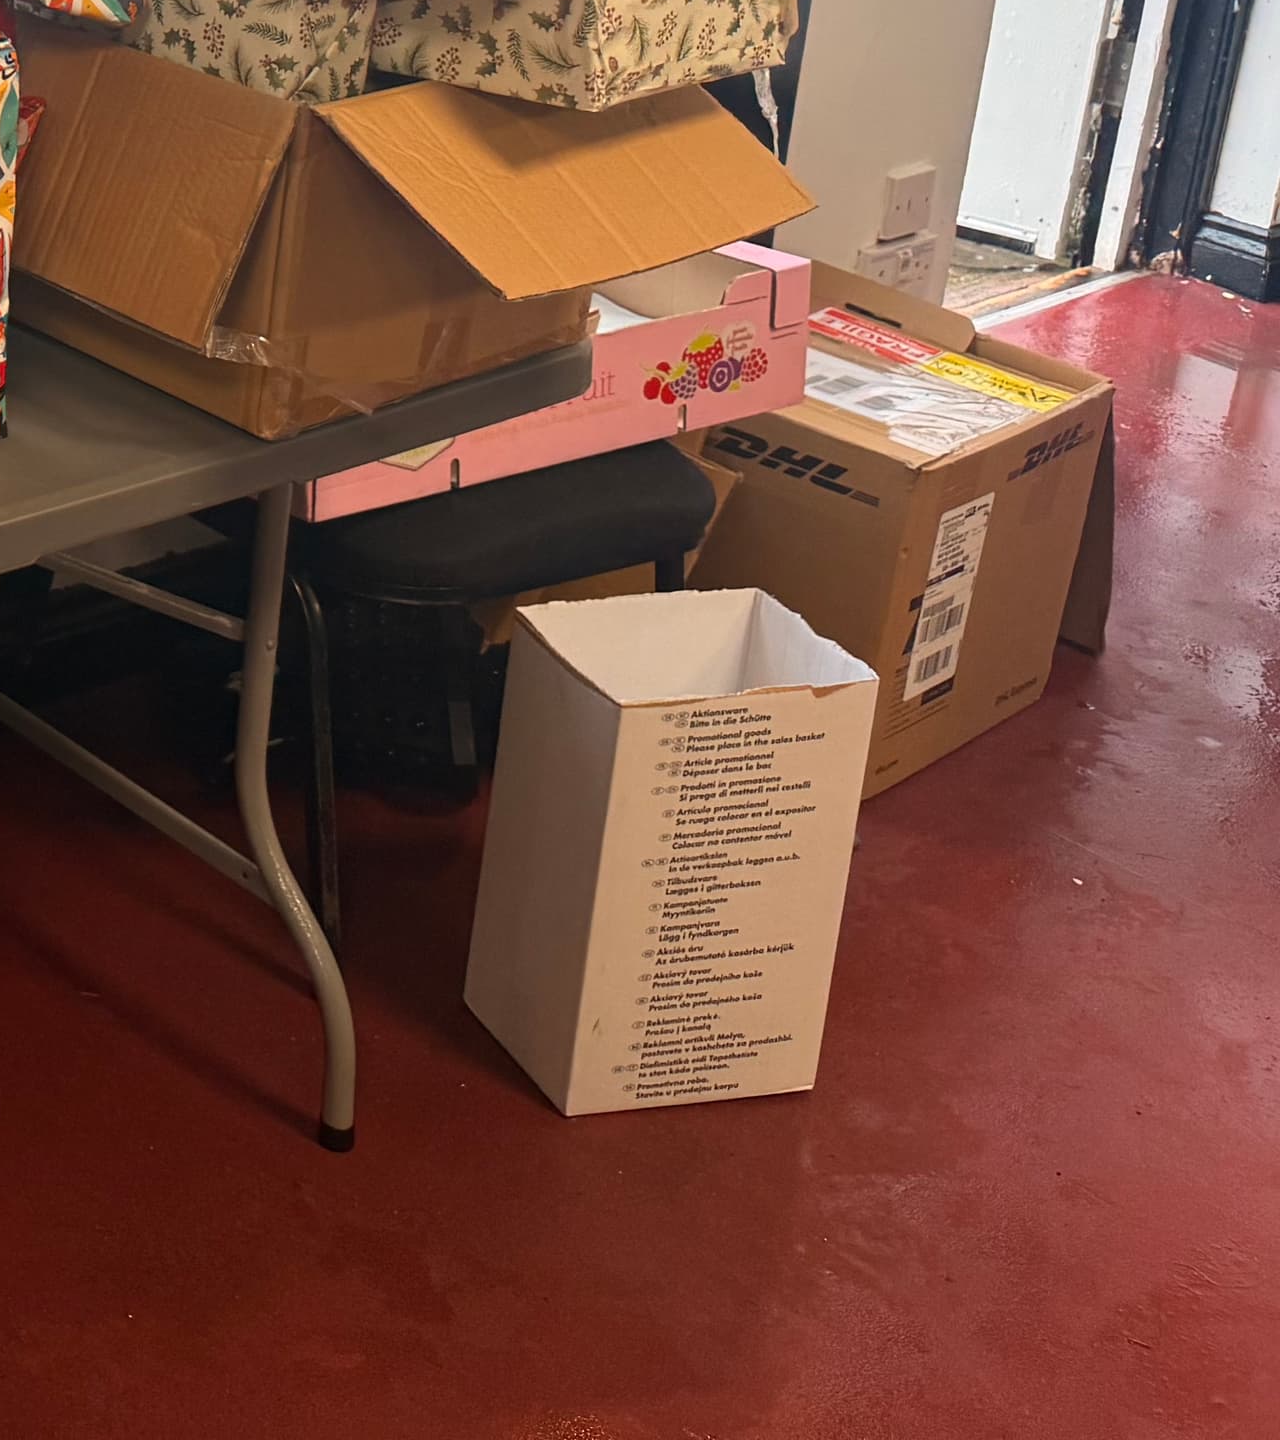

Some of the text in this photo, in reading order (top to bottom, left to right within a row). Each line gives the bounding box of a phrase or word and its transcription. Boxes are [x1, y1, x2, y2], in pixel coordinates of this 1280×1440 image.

[710, 426, 853, 497] DHL
[691, 705, 748, 719] Aktionsware
[690, 719, 709, 728] Bitte
[712, 717, 720, 726] in
[723, 716, 737, 725] die
[688, 726, 771, 742] Promotional goods
[687, 731, 824, 752] Please place in the sales basket
[684, 756, 712, 767] Article
[722, 763, 743, 773] dans
[718, 778, 726, 787] in
[680, 792, 687, 800] Si
[719, 788, 728, 797] di
[676, 816, 686, 825] Se
[765, 807, 772, 816] el
